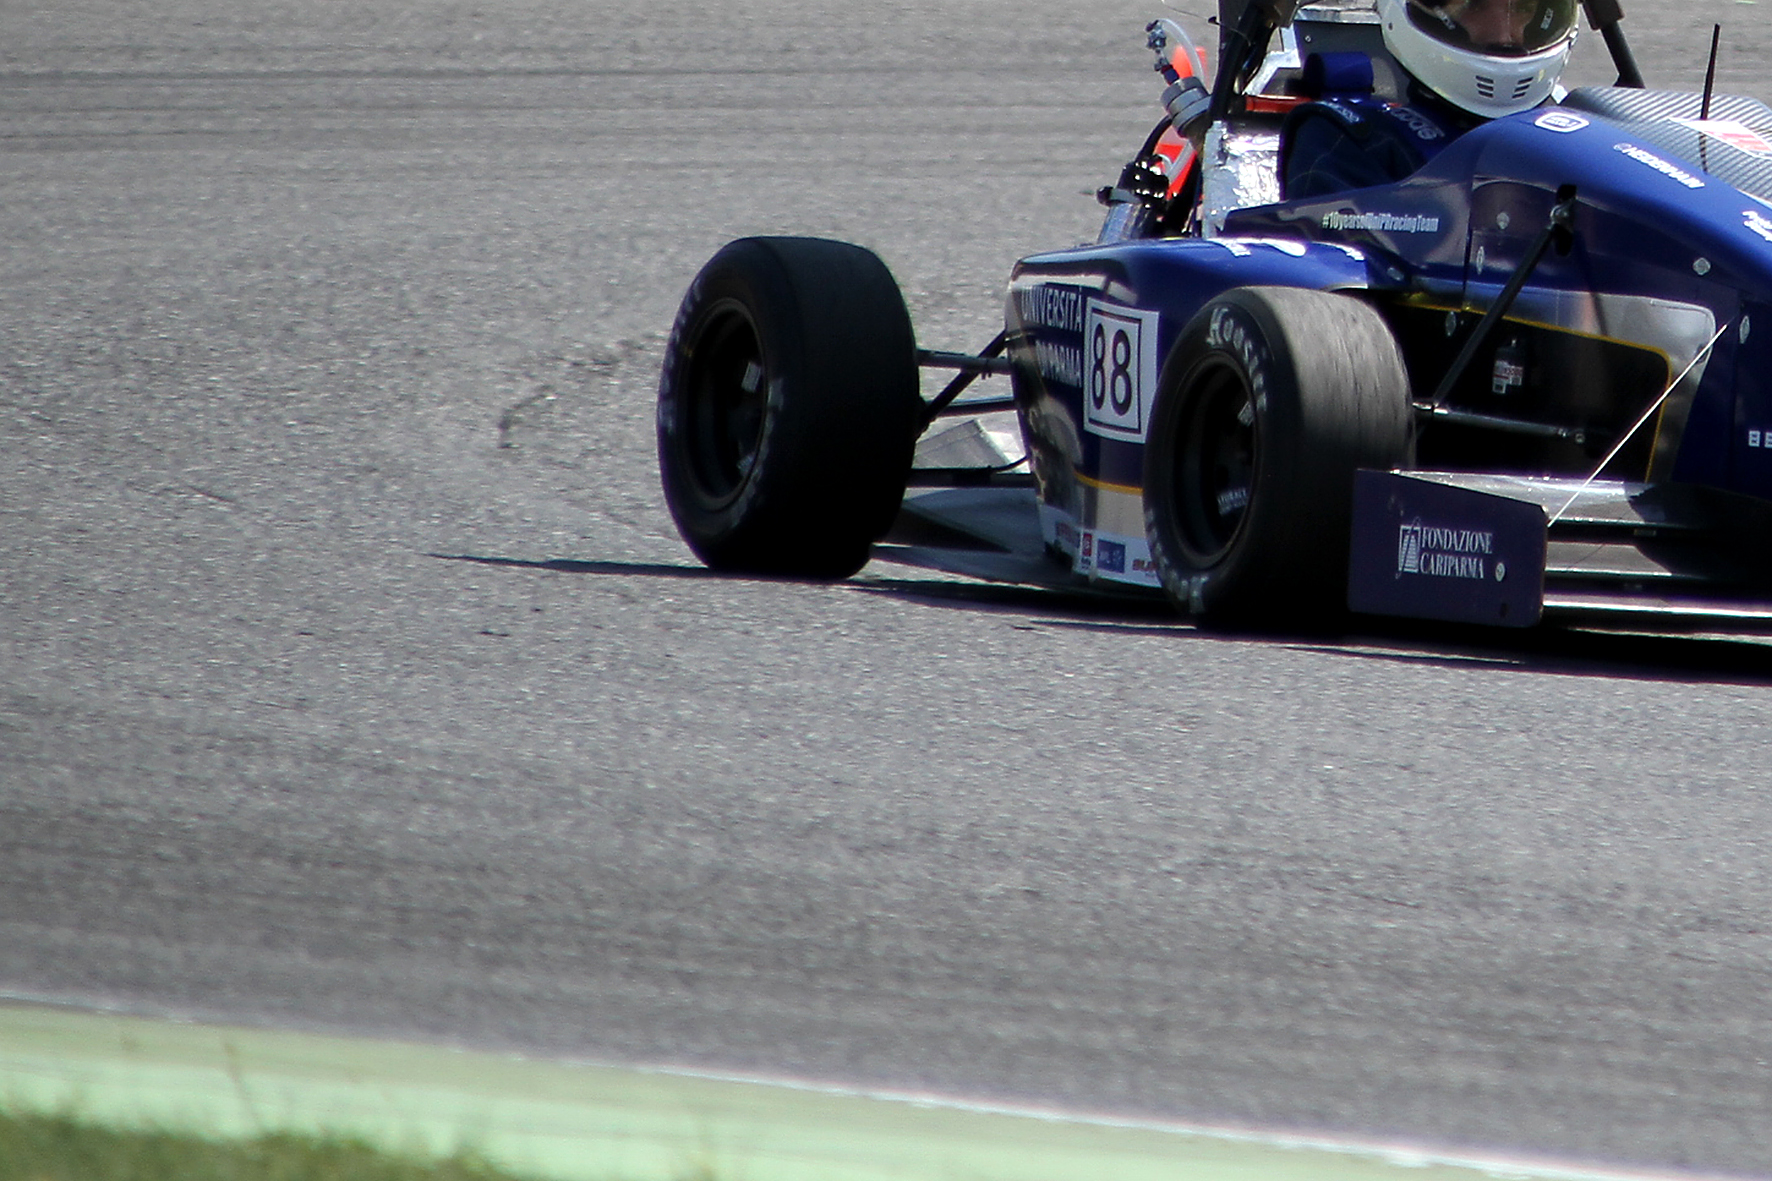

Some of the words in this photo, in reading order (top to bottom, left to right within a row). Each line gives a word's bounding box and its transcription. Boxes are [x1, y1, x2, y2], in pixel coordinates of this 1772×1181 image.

[1092, 323, 1133, 417] 88
[1421, 527, 1493, 554] FONDAZIONE
[1420, 552, 1484, 579] CARIPARMA
